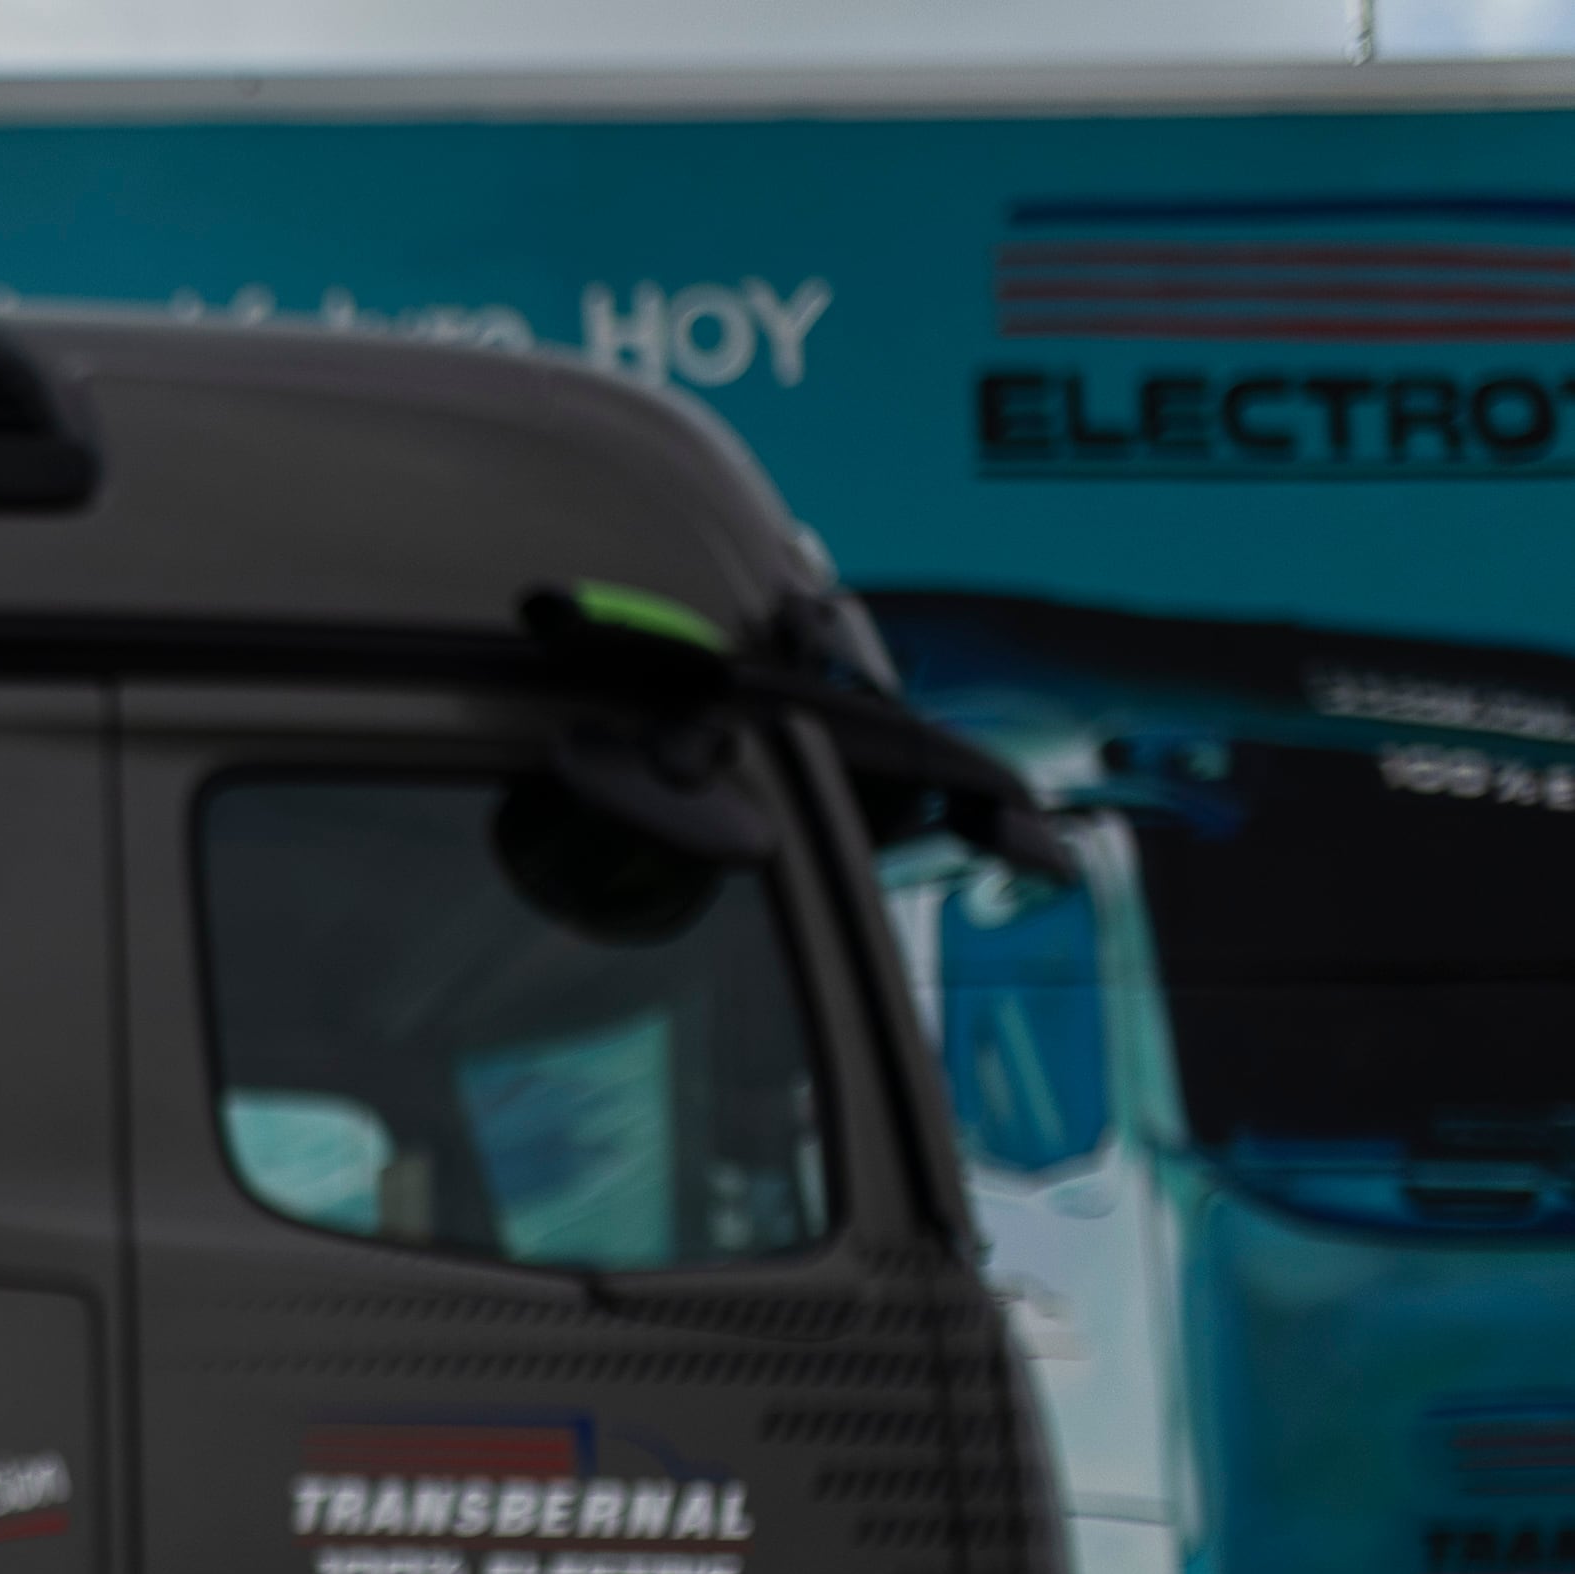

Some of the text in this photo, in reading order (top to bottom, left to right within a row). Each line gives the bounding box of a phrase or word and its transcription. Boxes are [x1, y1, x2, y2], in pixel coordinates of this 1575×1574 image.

[581, 275, 832, 387] HOY
[976, 372, 1575, 462] ELECTRO
[292, 1475, 754, 1542] TRANSBERNAL
